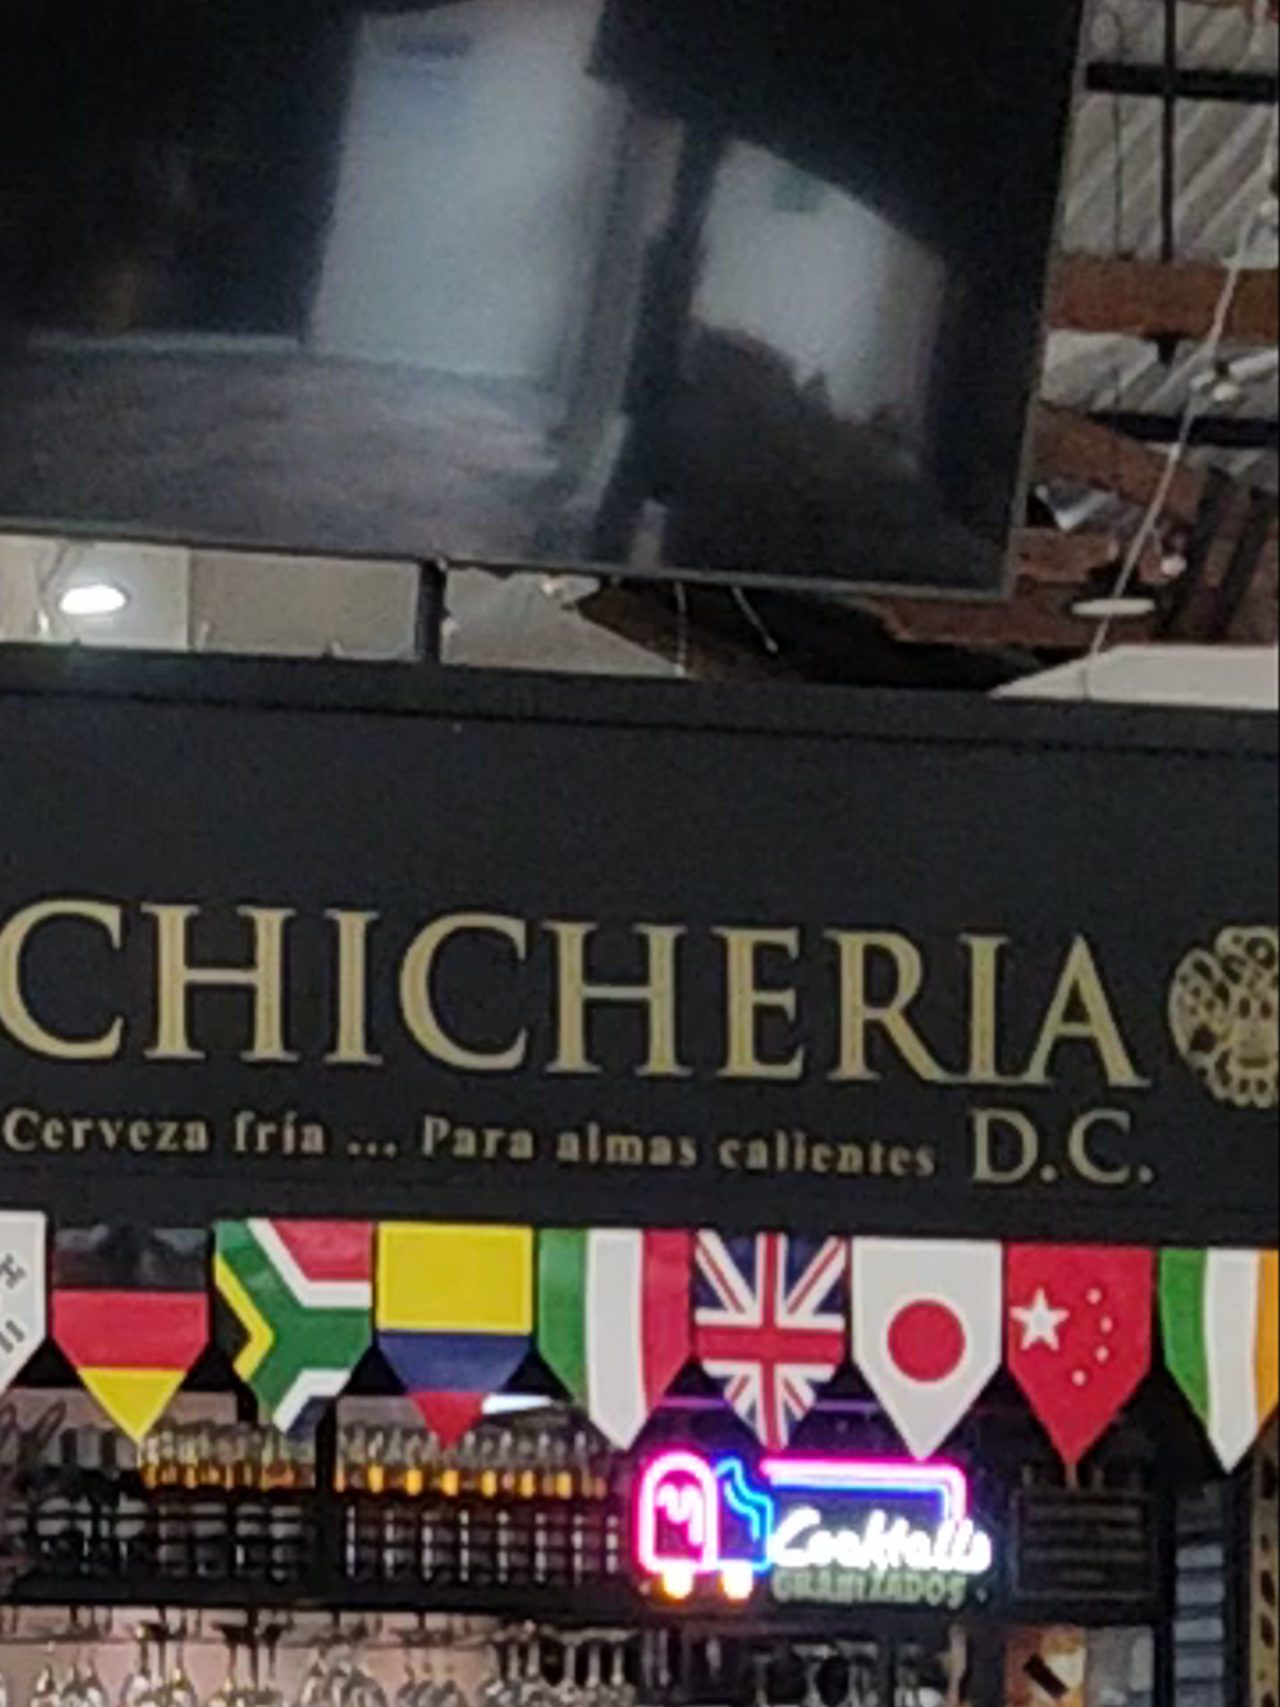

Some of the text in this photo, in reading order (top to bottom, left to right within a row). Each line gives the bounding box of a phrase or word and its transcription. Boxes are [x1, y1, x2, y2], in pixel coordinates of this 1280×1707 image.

[1, 1107, 209, 1153] Cerveza
[233, 1110, 326, 1156] fría
[422, 1114, 535, 1161] Para
[556, 1121, 698, 1167] almas
[719, 1129, 936, 1177] calientes
[971, 1106, 1154, 1185] D.C.
